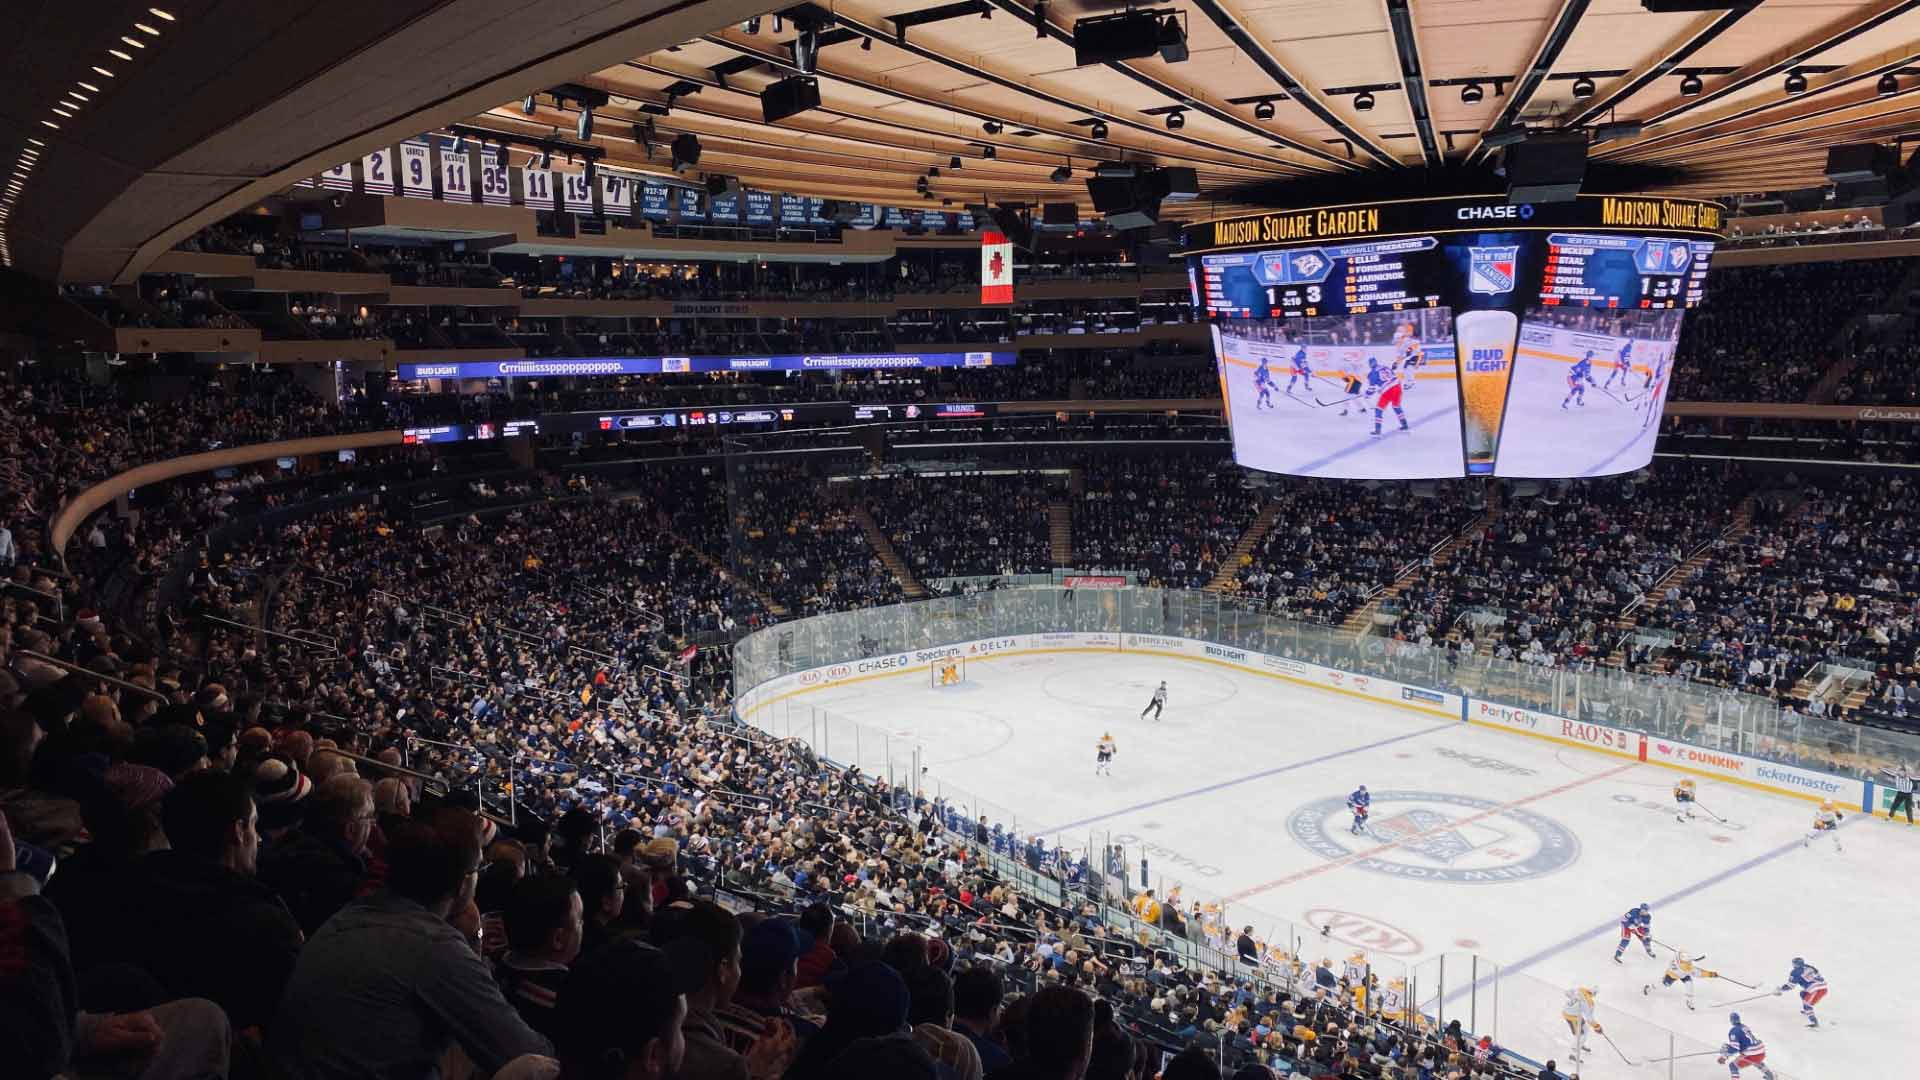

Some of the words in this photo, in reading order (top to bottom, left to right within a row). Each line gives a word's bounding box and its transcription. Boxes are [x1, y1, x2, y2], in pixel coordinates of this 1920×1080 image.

[371, 152, 385, 181] 2
[410, 158, 423, 185] 9
[446, 164, 466, 192] 11
[484, 168, 507, 194] 35
[529, 172, 548, 198] 11
[567, 175, 588, 201] 19
[1457, 205, 1517, 220] CHASE
[1603, 198, 1660, 225] MADISON
[1662, 200, 1697, 229] SQUARE
[1214, 219, 1260, 246] MADISON
[1263, 215, 1313, 242] SQUARE
[1317, 208, 1379, 237] GARDEN
[1376, 241, 1423, 251] PREDATORS
[1355, 254, 1380, 264] ELLIS
[1559, 257, 1585, 266] STAAL
[1356, 263, 1403, 273] FORSBERG
[1357, 272, 1406, 283] JARNKROK
[1306, 285, 1322, 303] 3
[1358, 284, 1378, 292] JOSI
[1543, 286, 1554, 294] 77
[1641, 278, 1650, 295] 1
[1671, 278, 1681, 296] 3
[1266, 288, 1276, 305] 1
[1358, 291, 1406, 301] JOHANSEN
[731, 359, 747, 367] BUD
[748, 359, 769, 367] LIGHT
[1472, 349, 1504, 361] BUD
[416, 367, 434, 375] BUD
[434, 366, 457, 375] LIGHT
[1466, 360, 1508, 372] LIGHT
[681, 414, 688, 425] 1
[707, 413, 717, 424] 3
[980, 639, 1017, 653] DELTA
[1205, 646, 1222, 656] BUD
[1223, 649, 1246, 662] LIGHT
[915, 647, 960, 663] Spectrum
[858, 658, 897, 673] CHASE
[1481, 703, 1538, 728] PartyCity
[1561, 719, 1614, 746] RAO'S
[1688, 750, 1744, 771] DUNKIN'
[1756, 766, 1840, 795] ticketmaster
